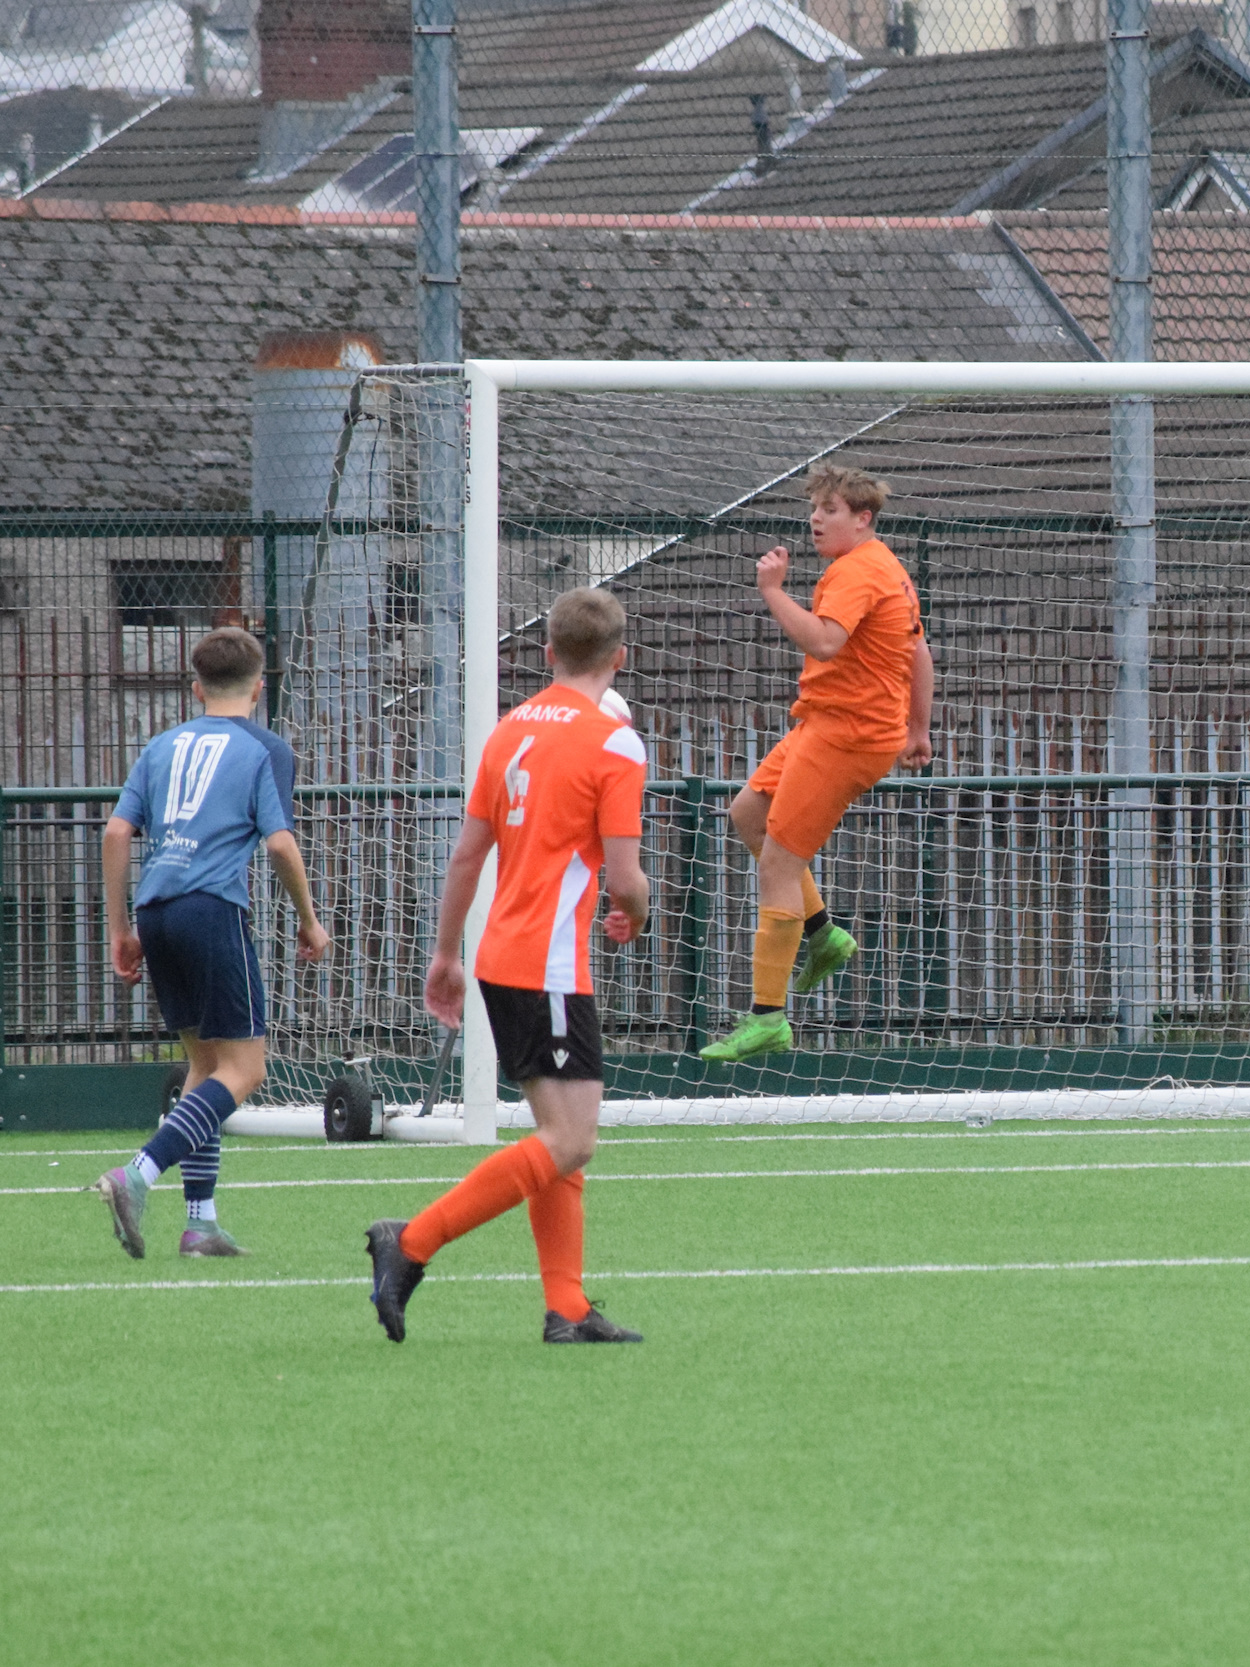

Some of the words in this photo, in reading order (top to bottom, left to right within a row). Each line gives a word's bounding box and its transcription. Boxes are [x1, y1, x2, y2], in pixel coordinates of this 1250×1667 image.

[508, 704, 581, 723] FRANCE
[163, 731, 231, 824] 10
[504, 735, 536, 827] 6
